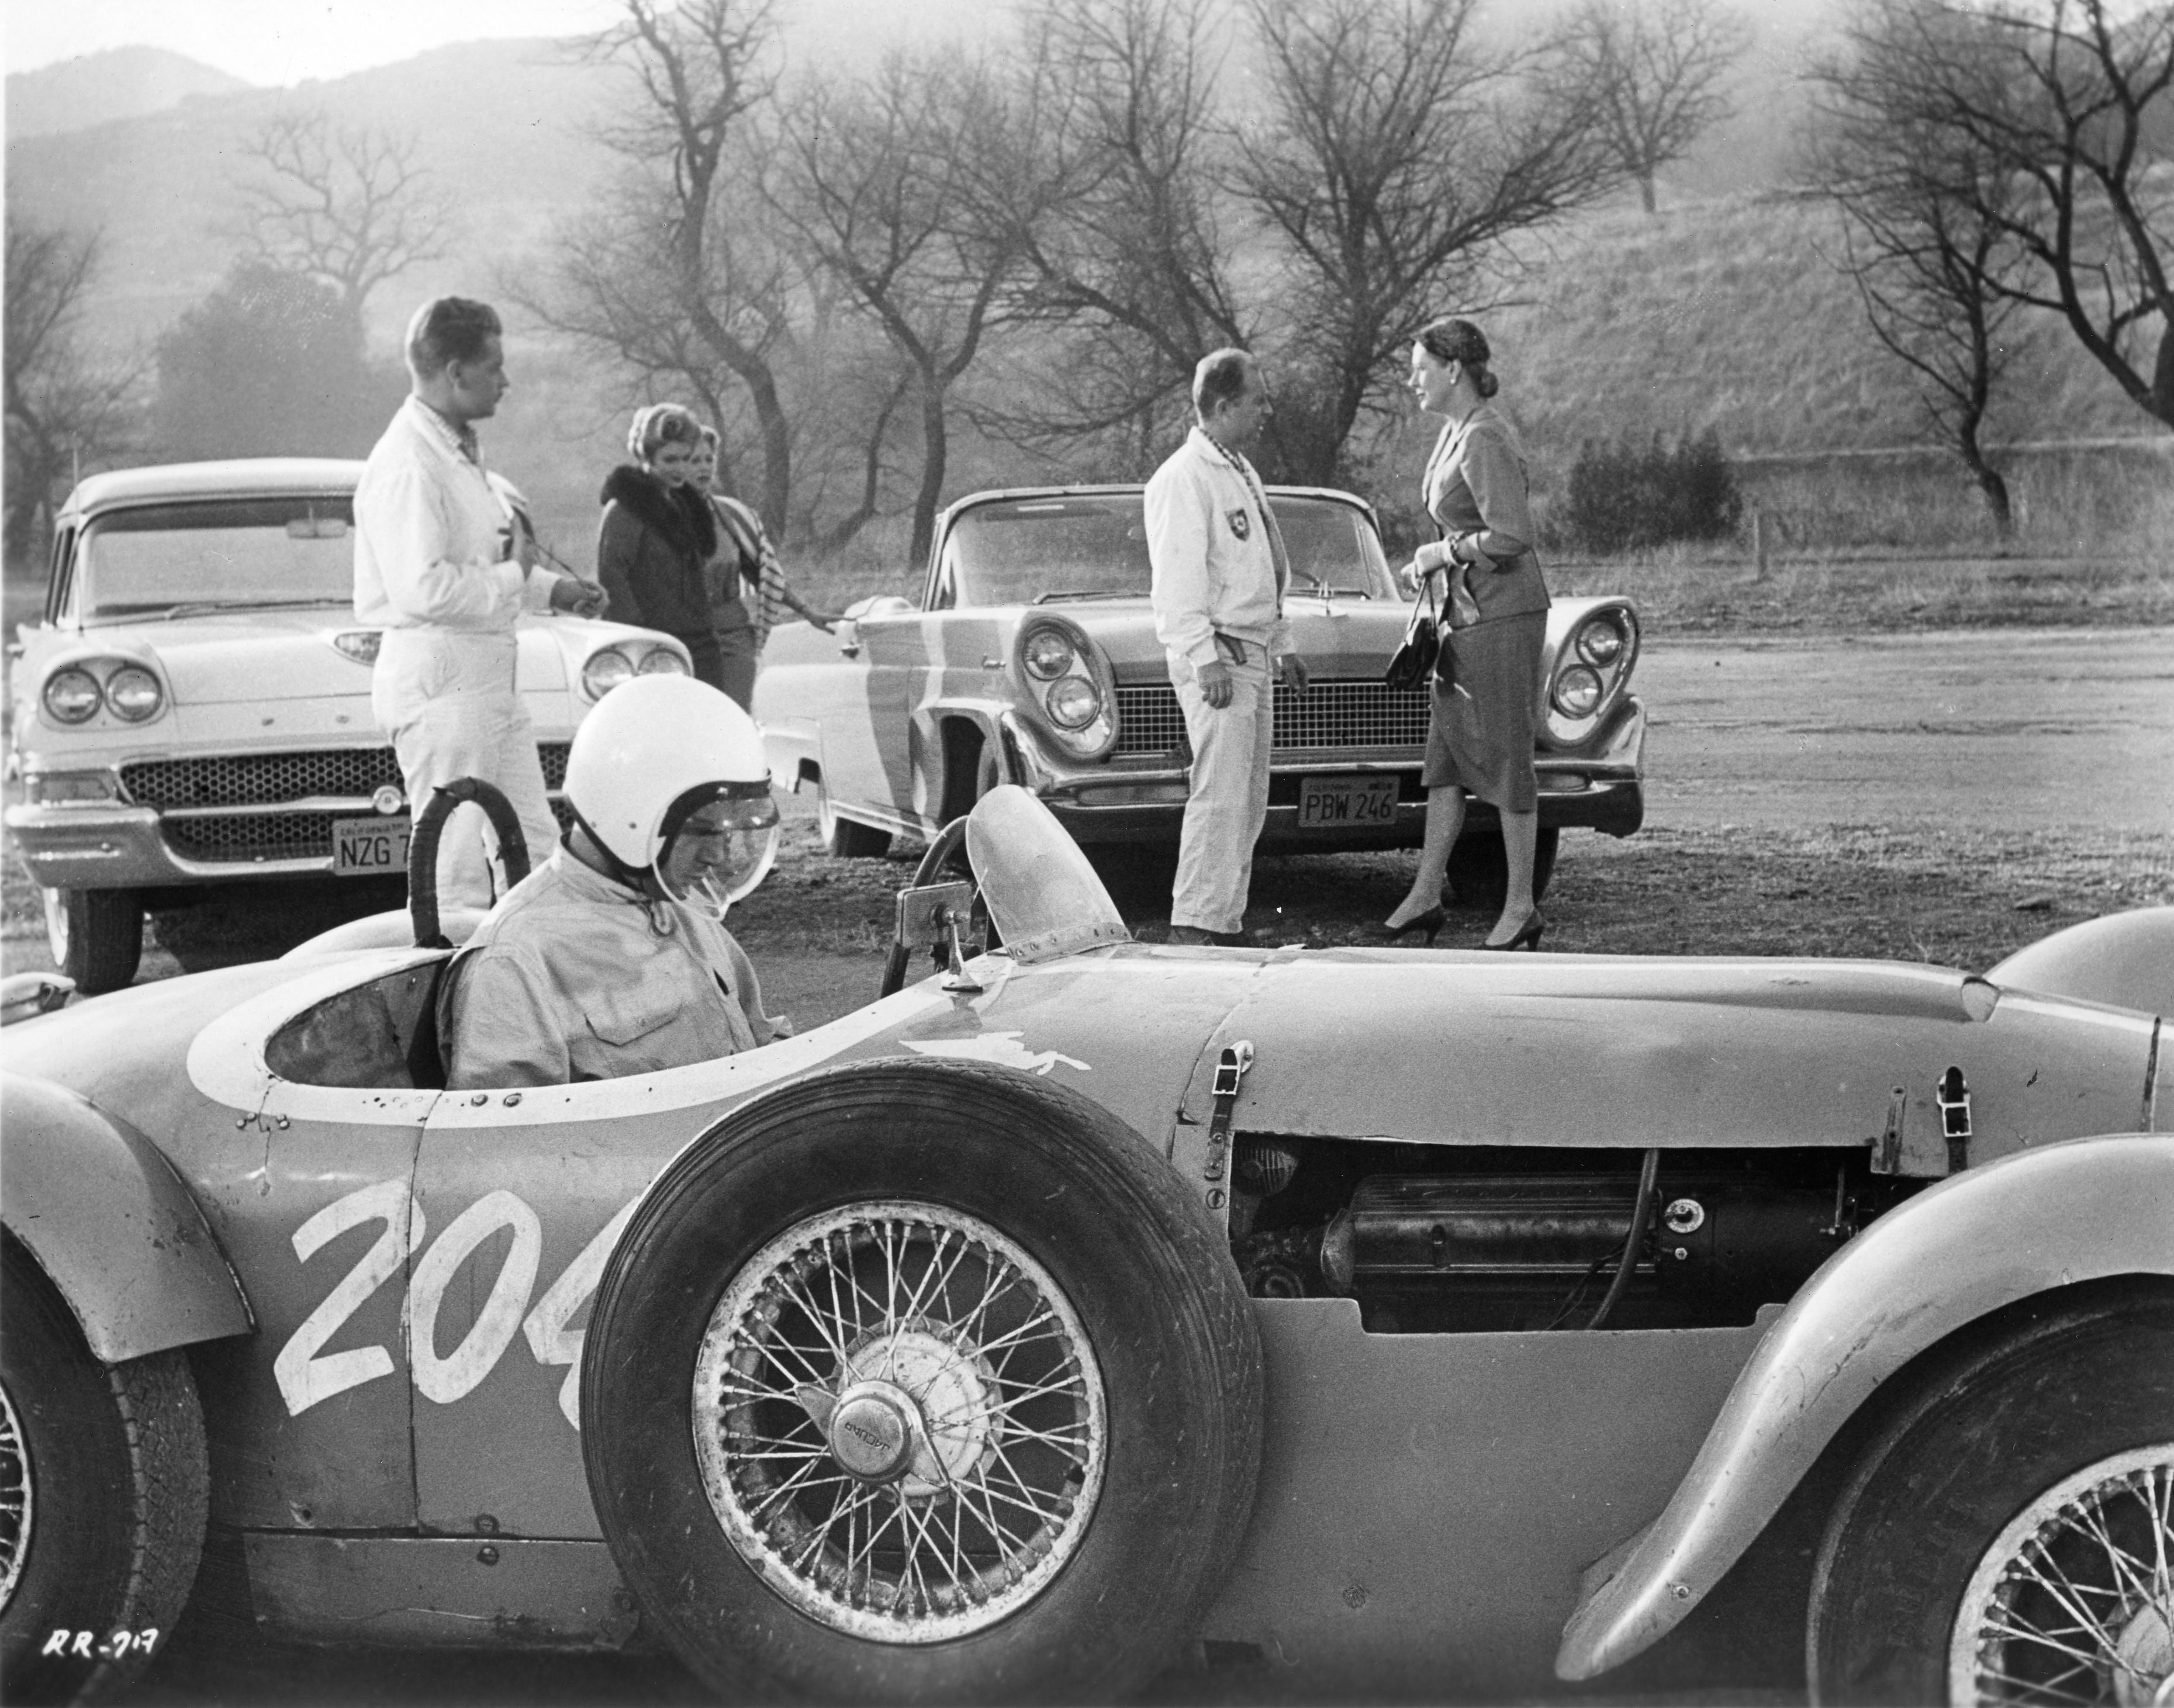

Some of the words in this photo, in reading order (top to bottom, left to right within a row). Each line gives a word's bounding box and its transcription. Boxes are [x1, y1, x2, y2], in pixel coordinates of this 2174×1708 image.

[1305, 794, 1349, 820] PBW
[1354, 793, 1392, 819] 246
[341, 836, 390, 867] NZG
[844, 1422, 891, 1451] JAGUAR
